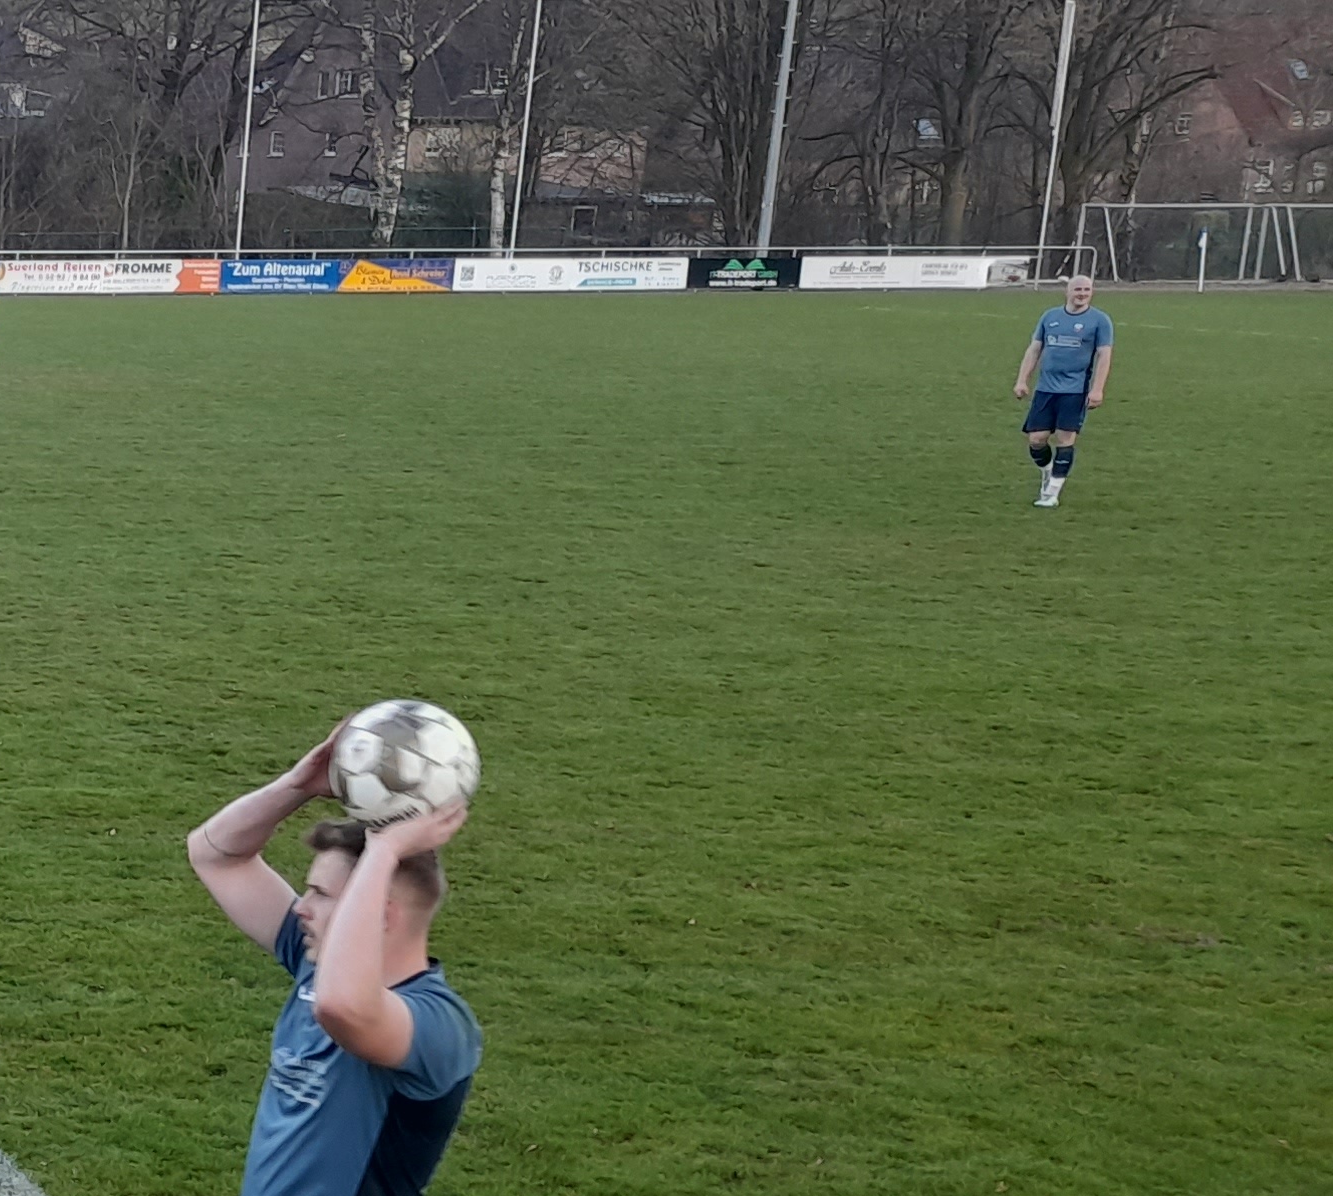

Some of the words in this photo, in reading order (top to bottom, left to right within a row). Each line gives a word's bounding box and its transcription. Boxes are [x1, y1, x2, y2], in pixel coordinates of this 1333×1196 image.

[64, 263, 101, 271] Reisen
[115, 263, 173, 273] FROMME
[578, 261, 654, 273] TSCHISCHKE
